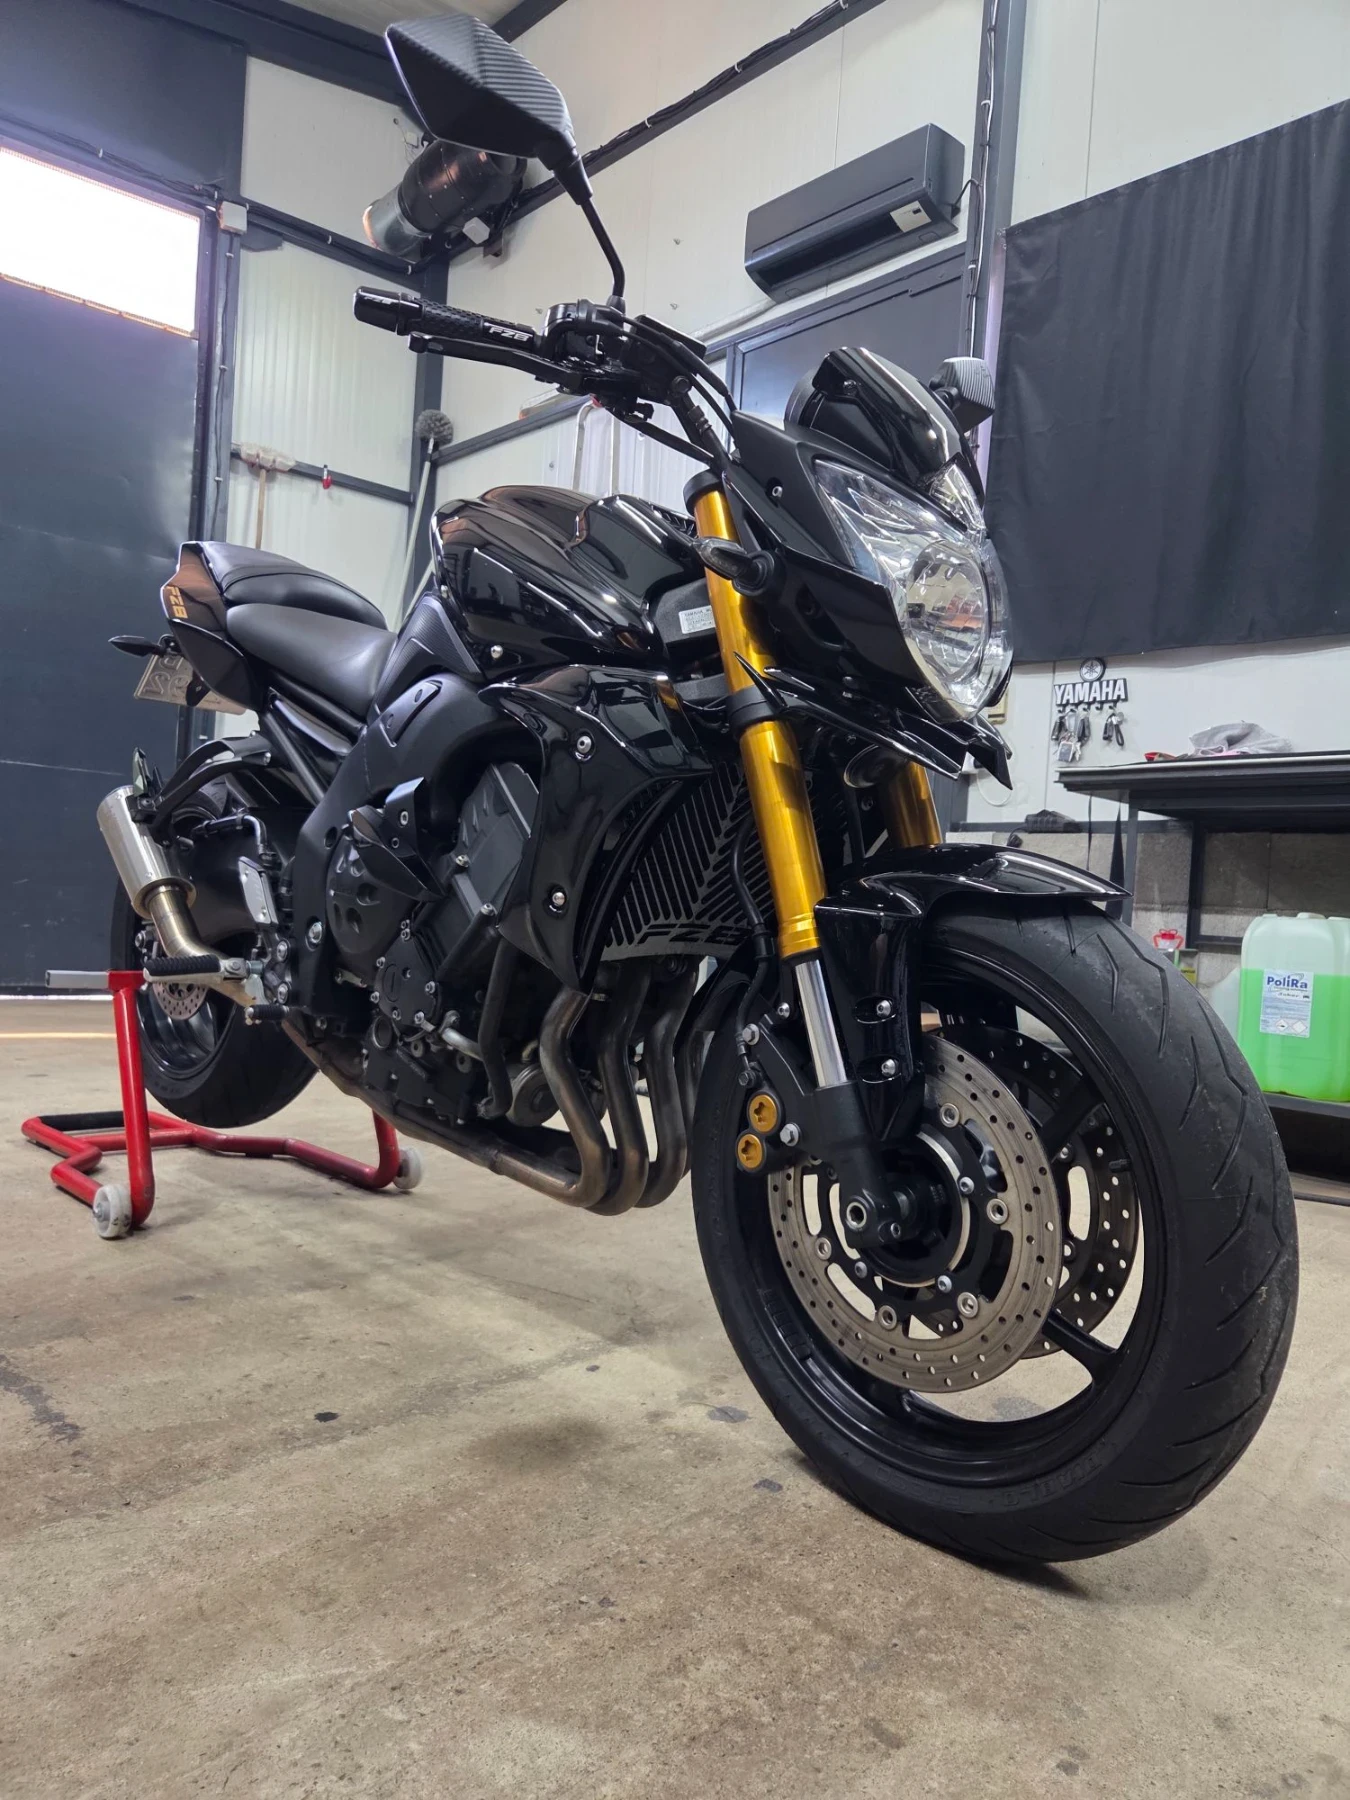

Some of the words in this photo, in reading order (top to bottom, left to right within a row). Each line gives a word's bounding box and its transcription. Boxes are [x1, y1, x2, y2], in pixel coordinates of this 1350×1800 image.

[489, 327, 529, 341] FZ8
[165, 585, 189, 619] FZ8
[1054, 679, 1126, 705] YAMAHA
[637, 923, 752, 947] FZ8
[1266, 975, 1308, 989] PoliRa
